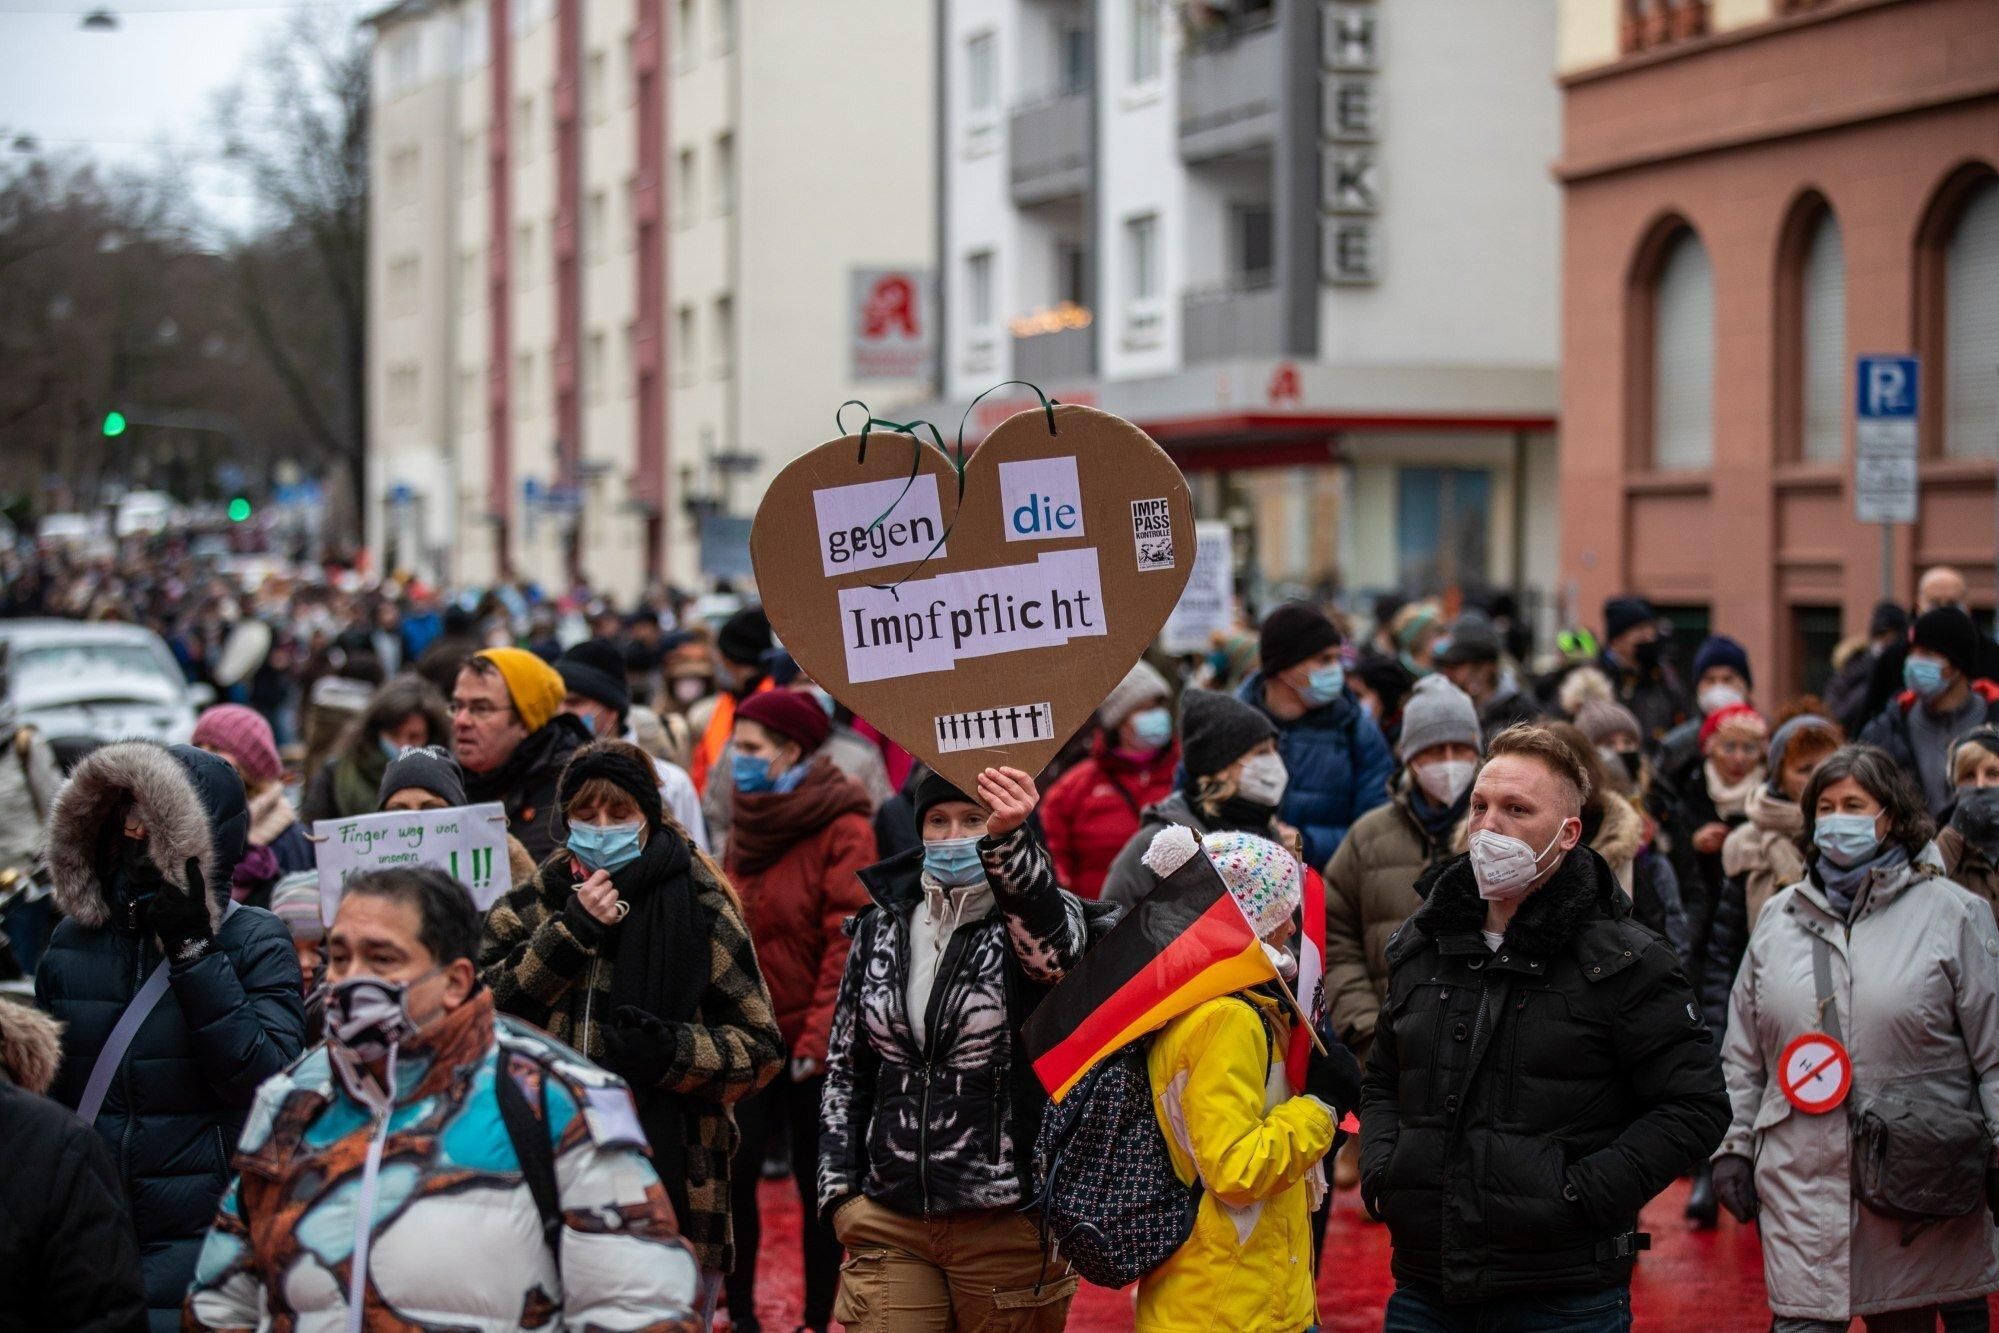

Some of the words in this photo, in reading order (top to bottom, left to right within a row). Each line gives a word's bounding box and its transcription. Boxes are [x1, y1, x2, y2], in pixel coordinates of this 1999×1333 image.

[1132, 500, 1168, 517] IMPF
[829, 516, 935, 563] gegen
[1012, 493, 1077, 534] die
[1134, 515, 1170, 532] PASS
[1136, 529, 1171, 539] KONTROLLE
[849, 589, 1093, 653] Impfpflicht
[338, 822, 389, 855] Finger
[398, 825, 424, 848] weg
[436, 822, 460, 835] von
[378, 852, 420, 864] unseren
